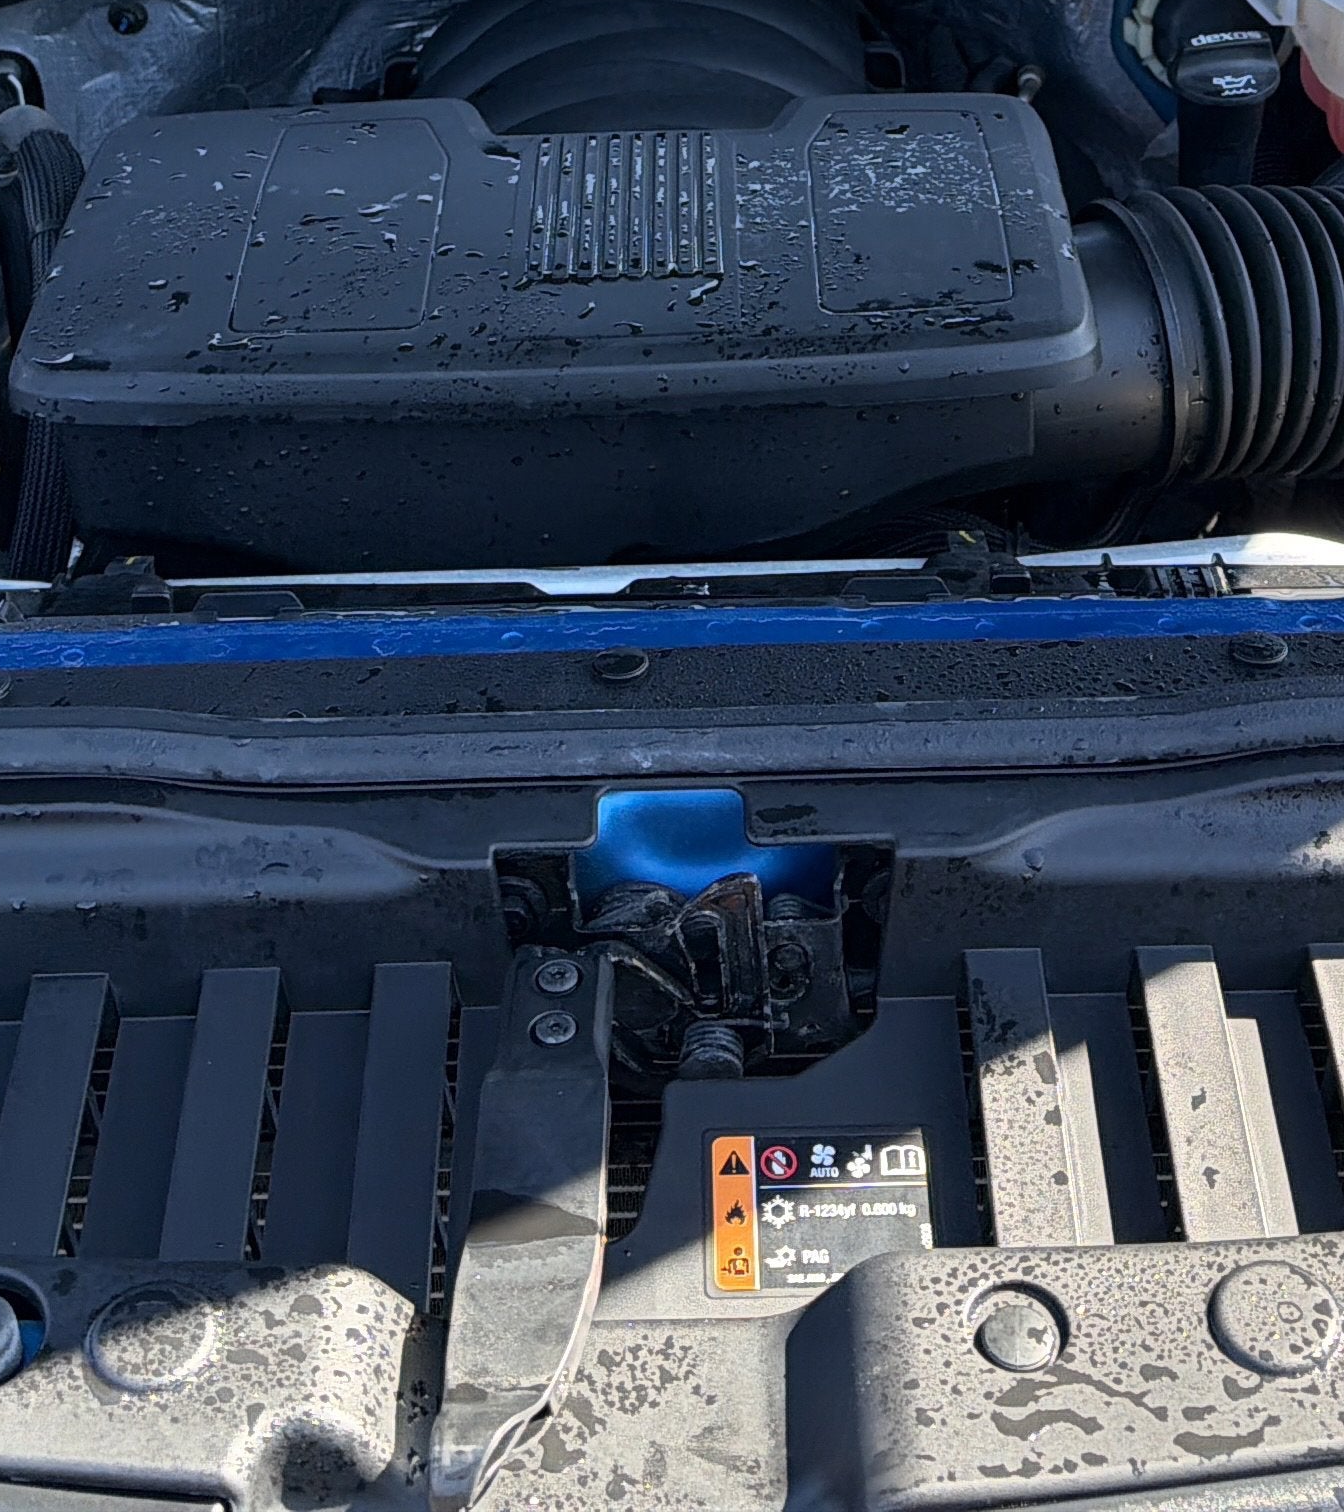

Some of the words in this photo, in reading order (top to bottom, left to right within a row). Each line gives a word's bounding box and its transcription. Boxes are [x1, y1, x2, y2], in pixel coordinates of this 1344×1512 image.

[1191, 31, 1261, 46] dexos
[809, 1166, 839, 1178] AUTO
[799, 1203, 856, 1220] R-1234yf
[899, 1201, 916, 1218] kg
[801, 1248, 830, 1264] PAG
